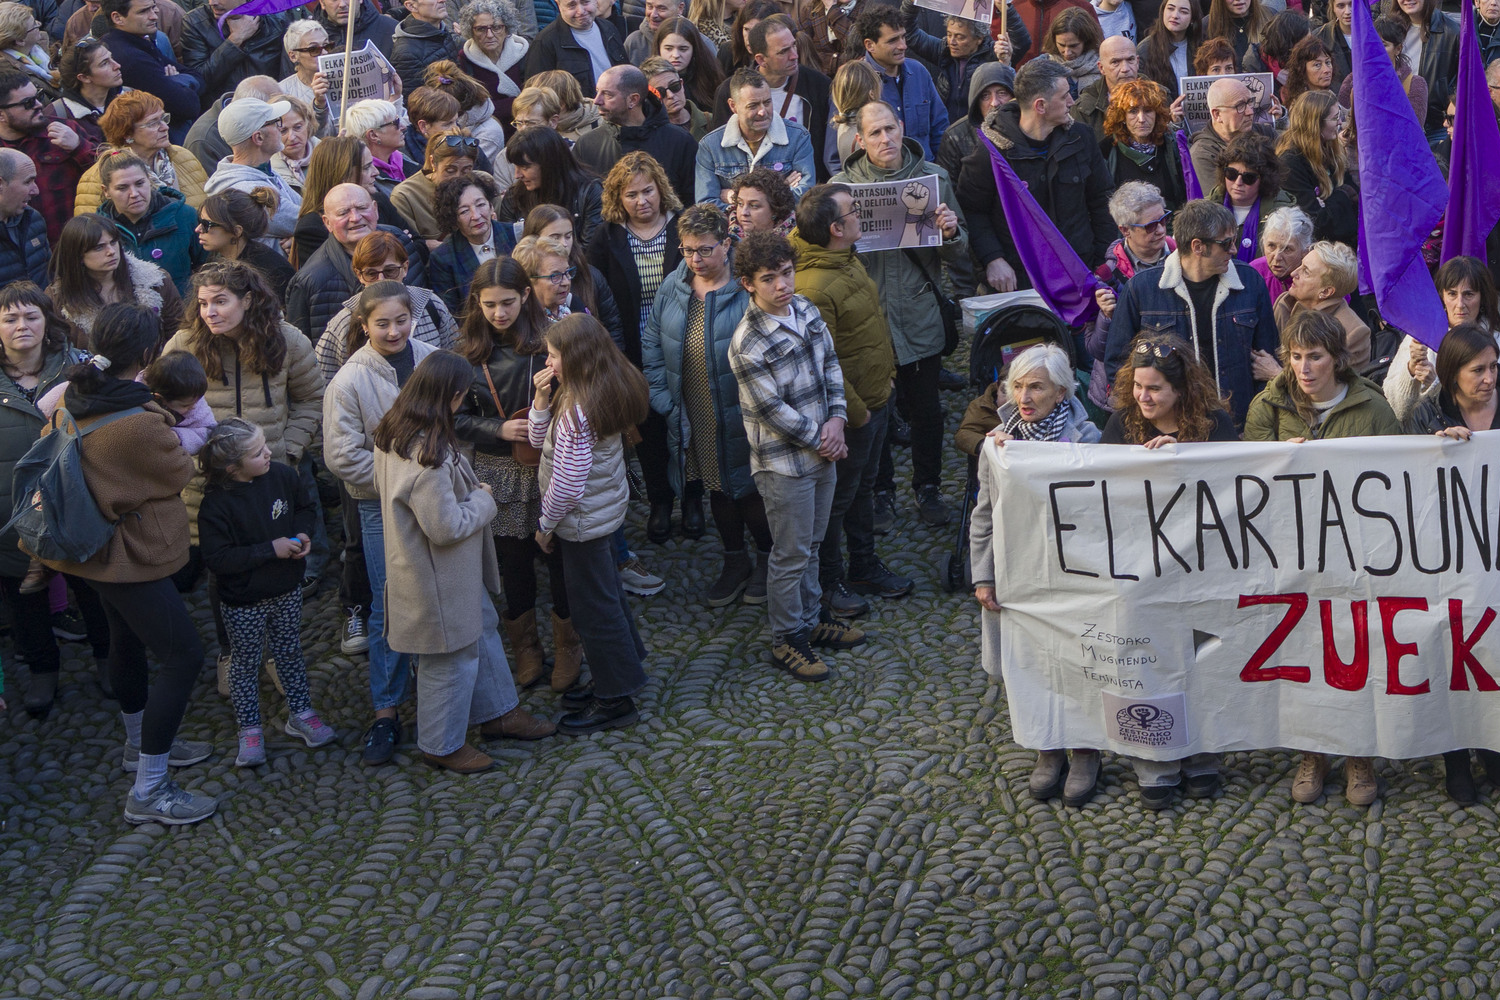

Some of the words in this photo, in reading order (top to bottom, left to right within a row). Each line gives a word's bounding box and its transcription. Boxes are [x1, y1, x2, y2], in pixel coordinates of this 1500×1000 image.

[1187, 92, 1195, 101] EZ
[1198, 92, 1207, 100] DA
[864, 198, 898, 207] DELITUA
[1081, 622, 1151, 645] ZESTOAKO
[1081, 643, 1157, 666] MUGIMENDU
[1119, 727, 1171, 737] ZESTOAKO
[1120, 732, 1172, 741] MUGIMENDU
[1123, 736, 1167, 746] FEMINISTA
